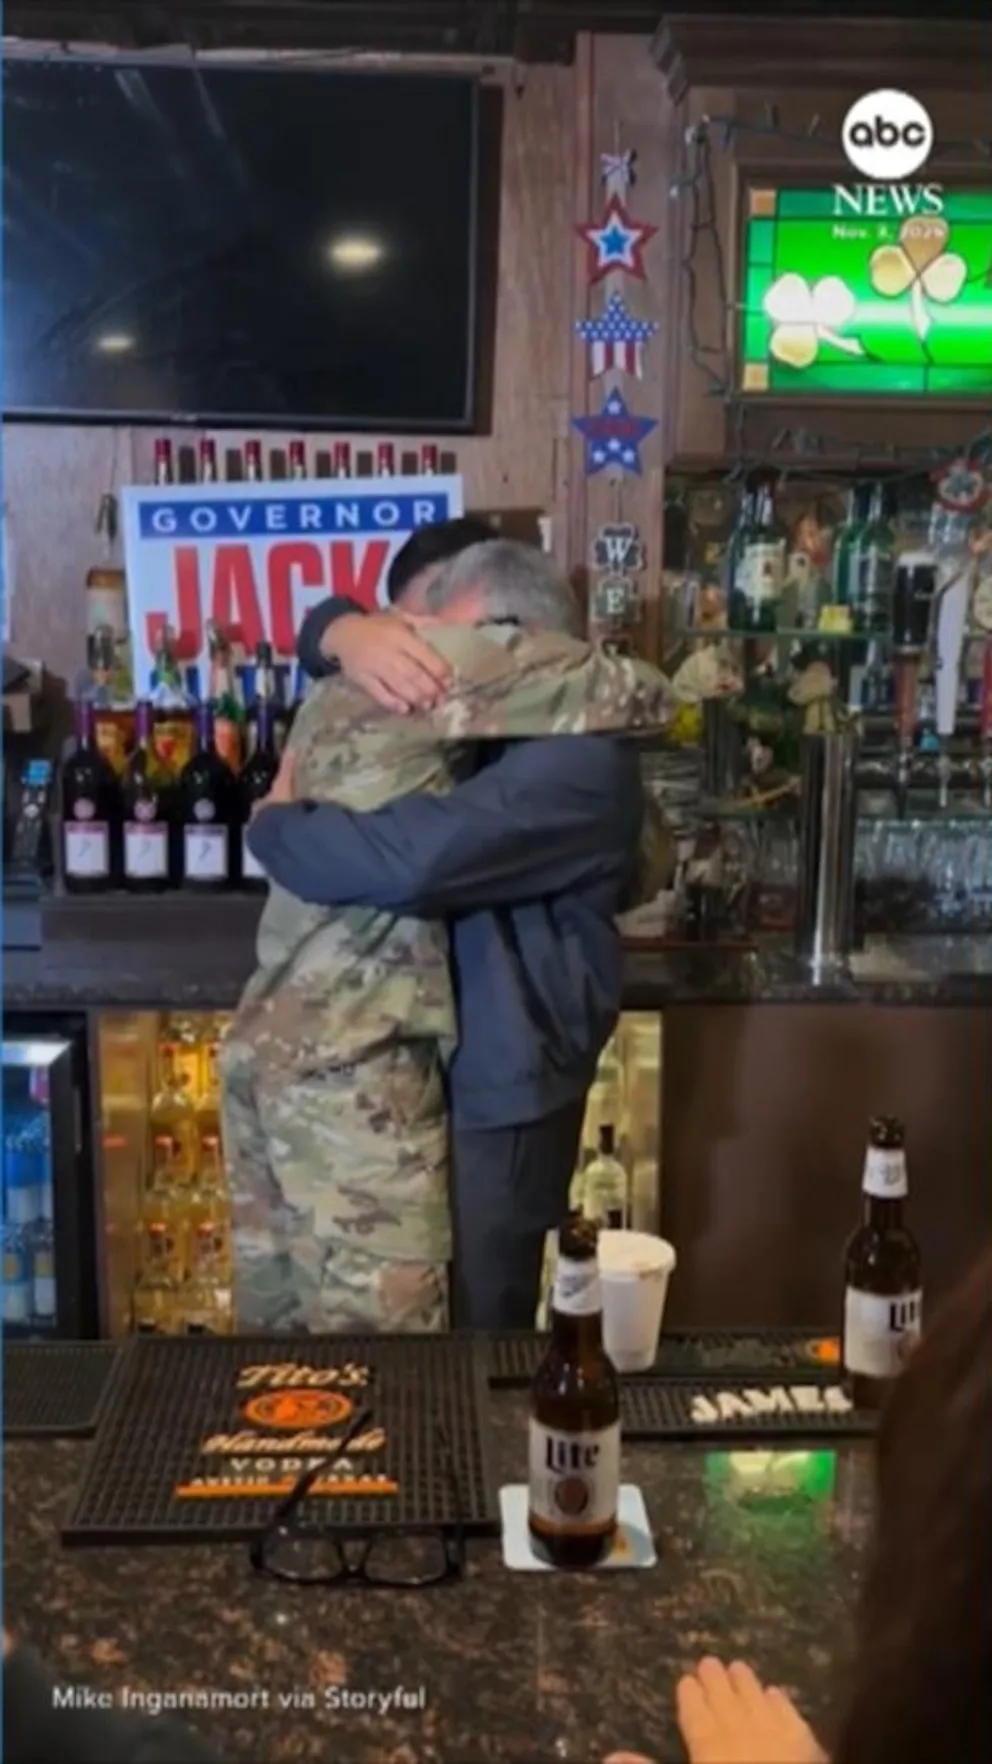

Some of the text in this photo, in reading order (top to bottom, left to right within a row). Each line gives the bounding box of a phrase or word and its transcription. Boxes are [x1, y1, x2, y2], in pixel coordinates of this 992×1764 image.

[152, 499, 436, 532] GOVERNOR
[237, 1363, 369, 1388] Tito's
[546, 1436, 600, 1475] Lite
